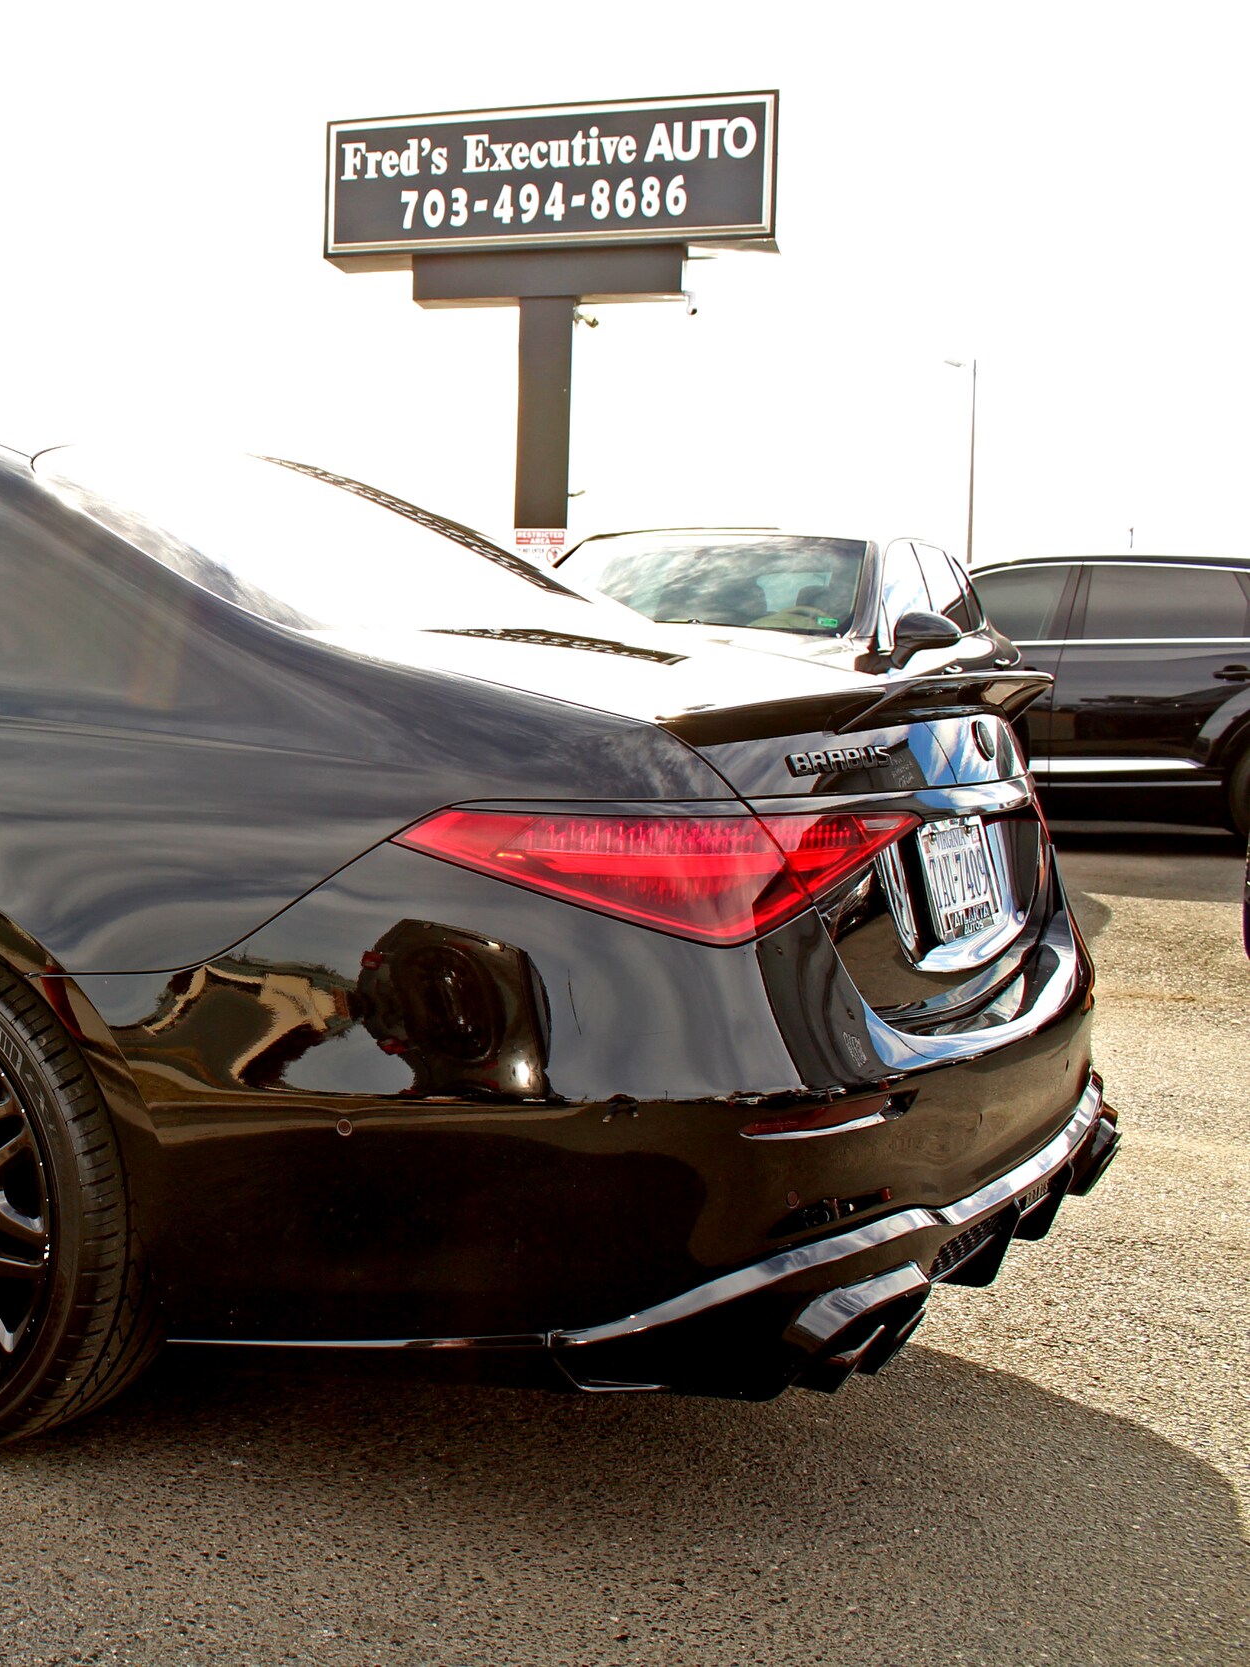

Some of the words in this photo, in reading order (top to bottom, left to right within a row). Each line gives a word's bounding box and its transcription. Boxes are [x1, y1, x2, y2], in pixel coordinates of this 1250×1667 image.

[341, 138, 448, 181] Fred's
[462, 126, 637, 174] Executive
[643, 116, 757, 163] AUTO
[400, 174, 688, 230] 703-494-8686
[789, 745, 891, 776] BRABUS
